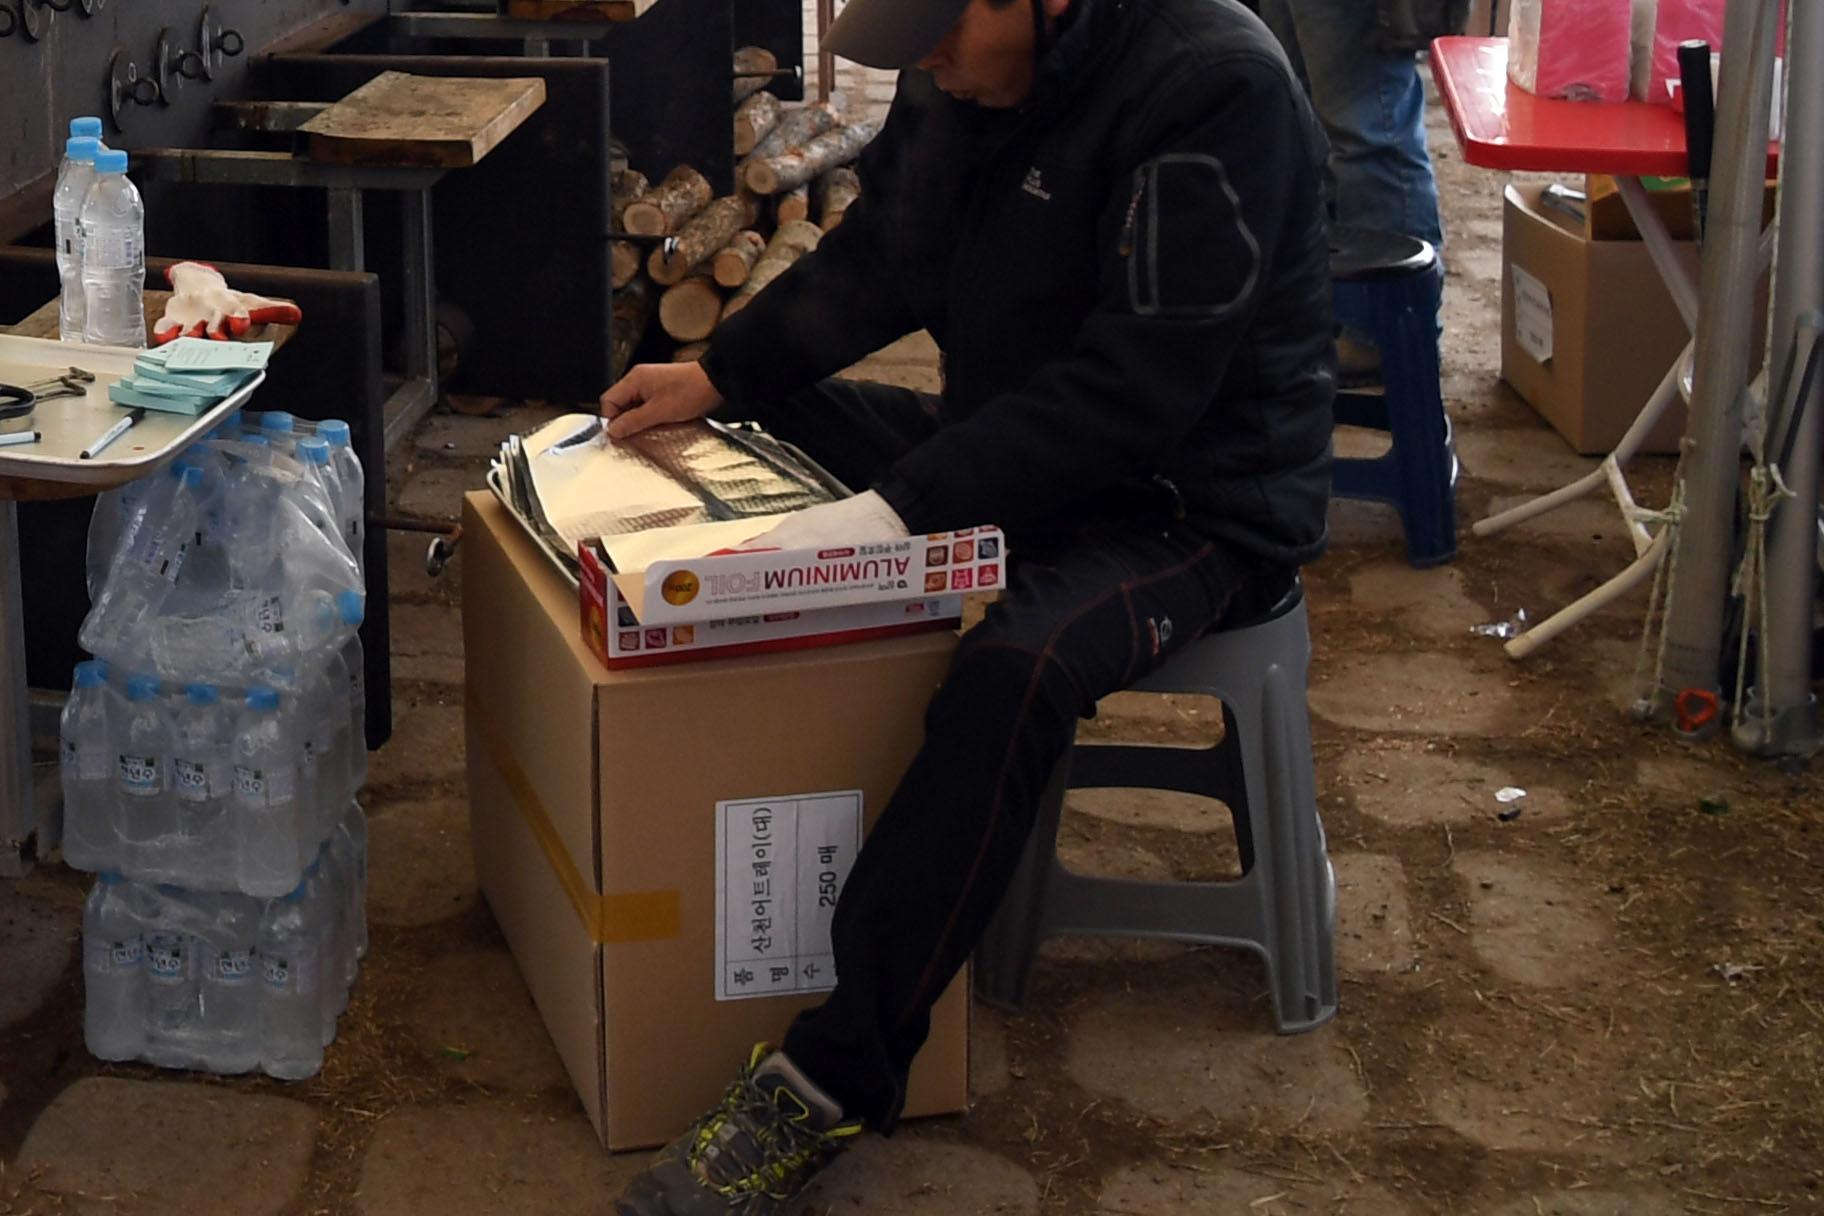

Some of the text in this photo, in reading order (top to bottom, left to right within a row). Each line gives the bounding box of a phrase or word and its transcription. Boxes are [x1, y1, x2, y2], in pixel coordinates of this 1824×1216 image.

[704, 571, 760, 596] FOIL
[764, 556, 911, 590] ALUMINIUM
[750, 806, 773, 954] 산천어트레이(대)
[818, 845, 838, 907] 250 매
[733, 966, 790, 985] 품 명
[803, 963, 821, 980] 수
